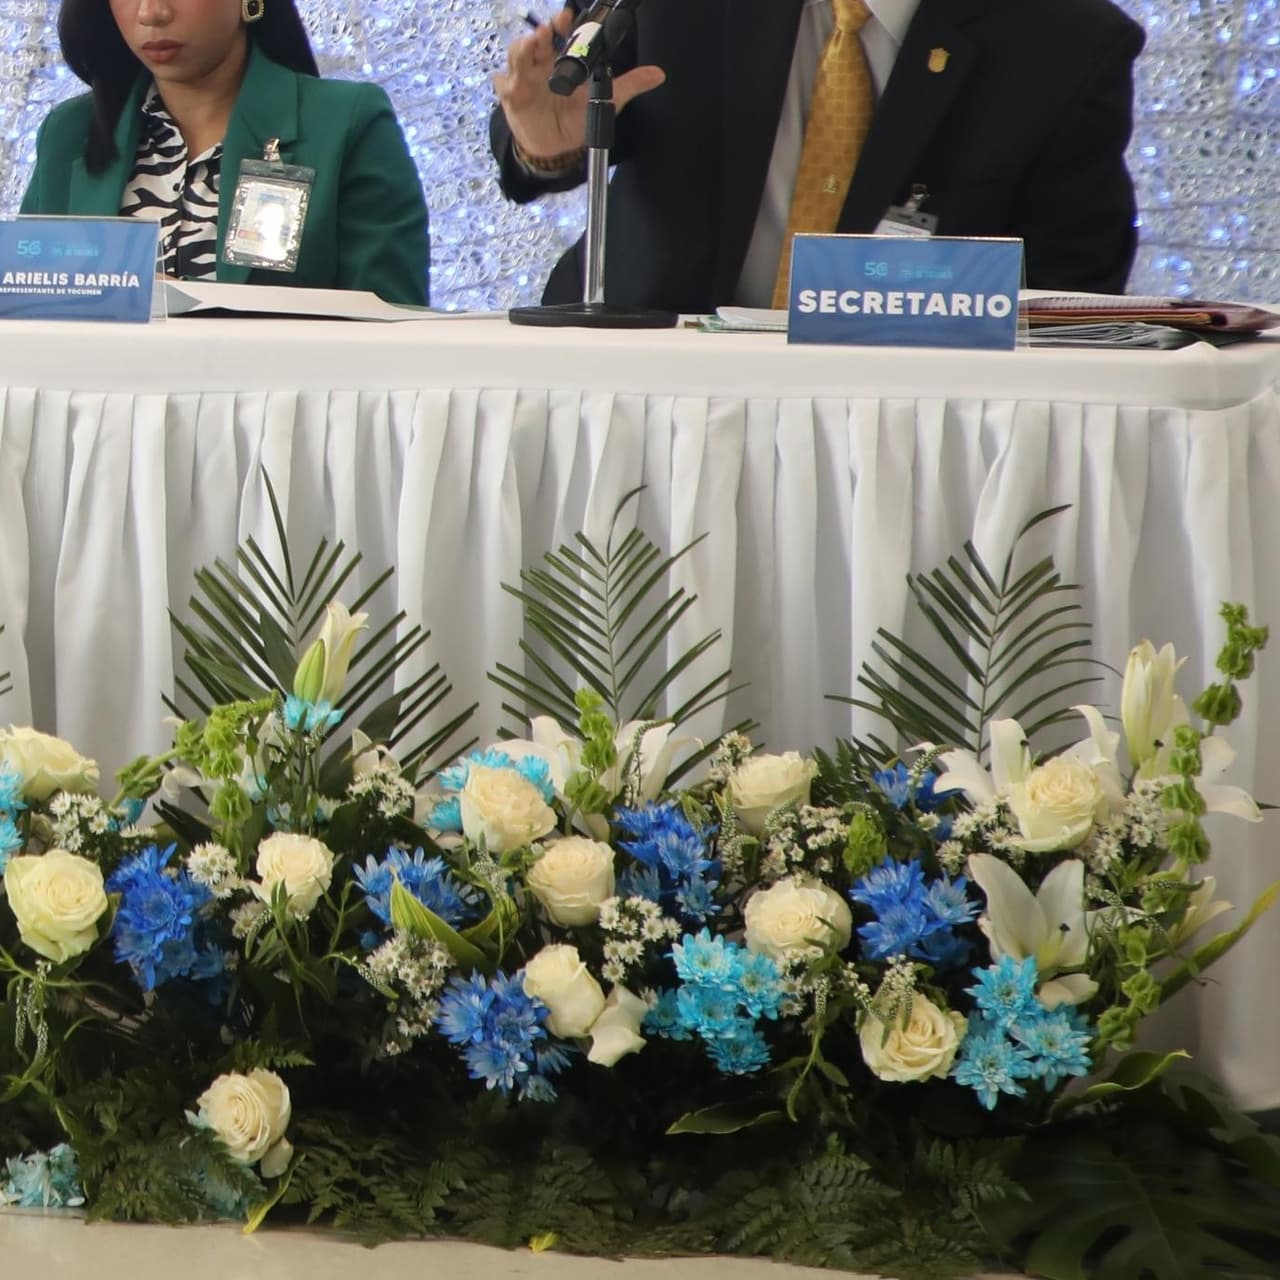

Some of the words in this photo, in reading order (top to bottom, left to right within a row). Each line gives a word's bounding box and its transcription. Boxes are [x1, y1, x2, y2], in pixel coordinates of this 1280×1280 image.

[2, 271, 69, 286] ARIELIS
[74, 271, 140, 288] BARRÍA
[67, 288, 102, 296] TOCUMEN
[797, 289, 1012, 318] SECRETARIO
